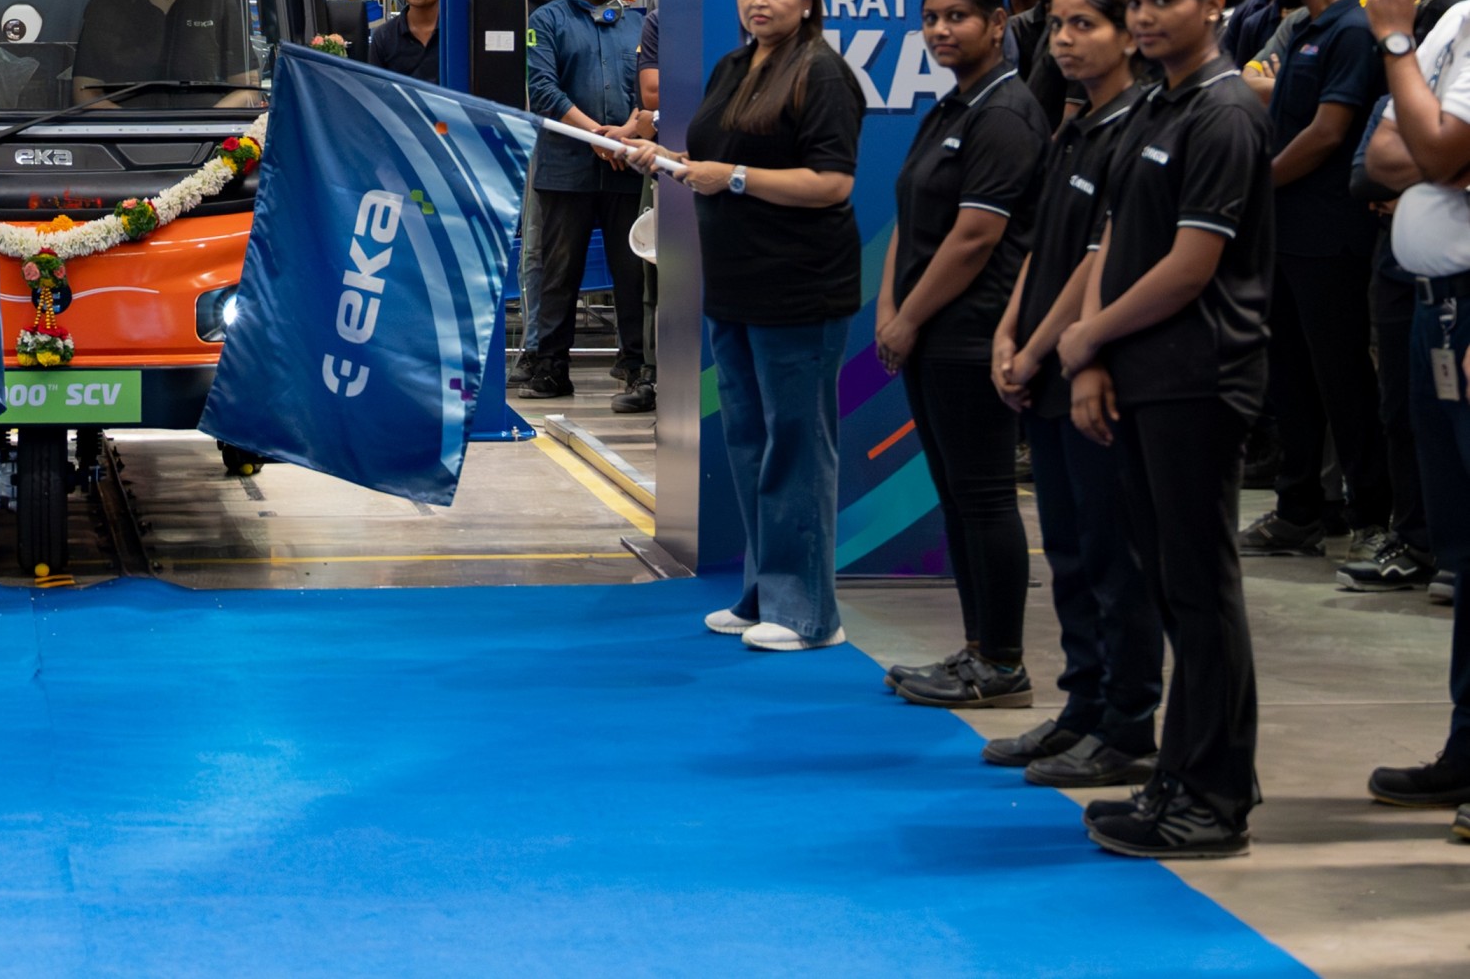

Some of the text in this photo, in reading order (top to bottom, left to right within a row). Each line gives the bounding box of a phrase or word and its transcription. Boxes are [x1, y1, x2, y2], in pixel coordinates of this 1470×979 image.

[822, 29, 957, 109] KA
[14, 148, 73, 166] eka
[65, 383, 122, 406] SCV
